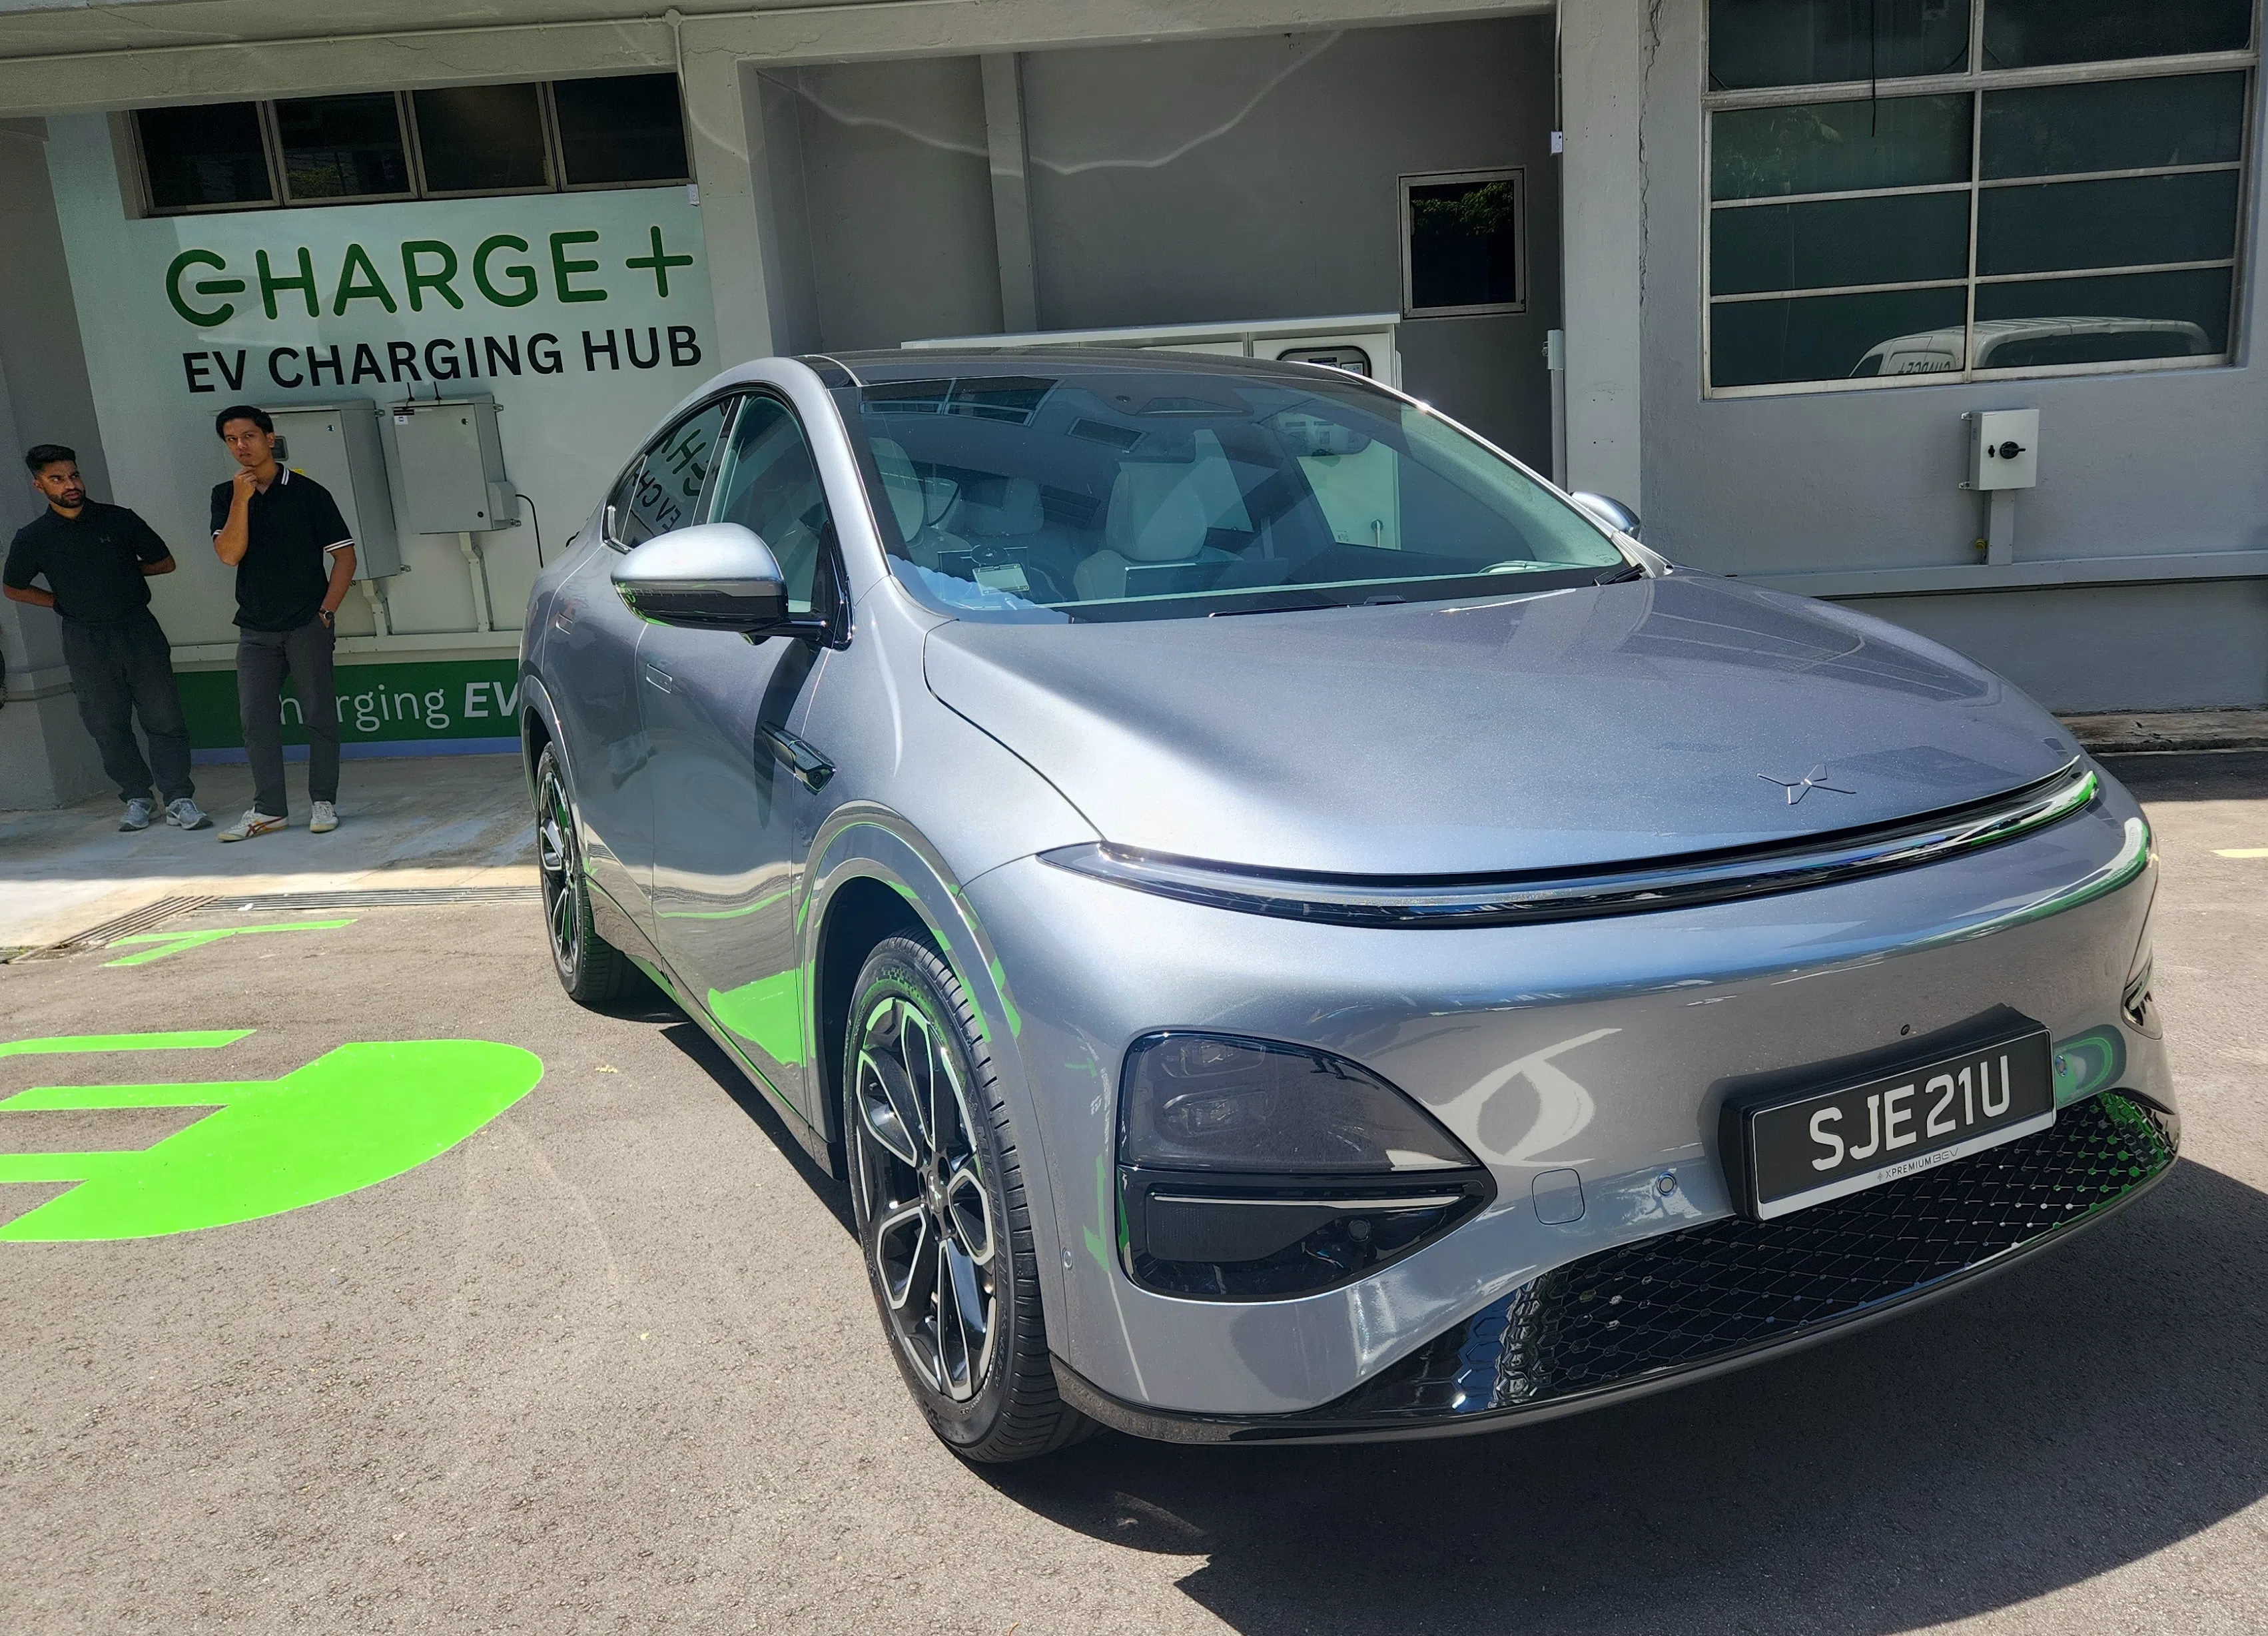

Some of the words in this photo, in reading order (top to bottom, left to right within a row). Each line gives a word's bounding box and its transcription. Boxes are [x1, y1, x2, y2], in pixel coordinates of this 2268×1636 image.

[183, 349, 246, 393] EV
[268, 332, 564, 387] CHARGING
[581, 325, 702, 372] HUB
[278, 684, 450, 732] hrging
